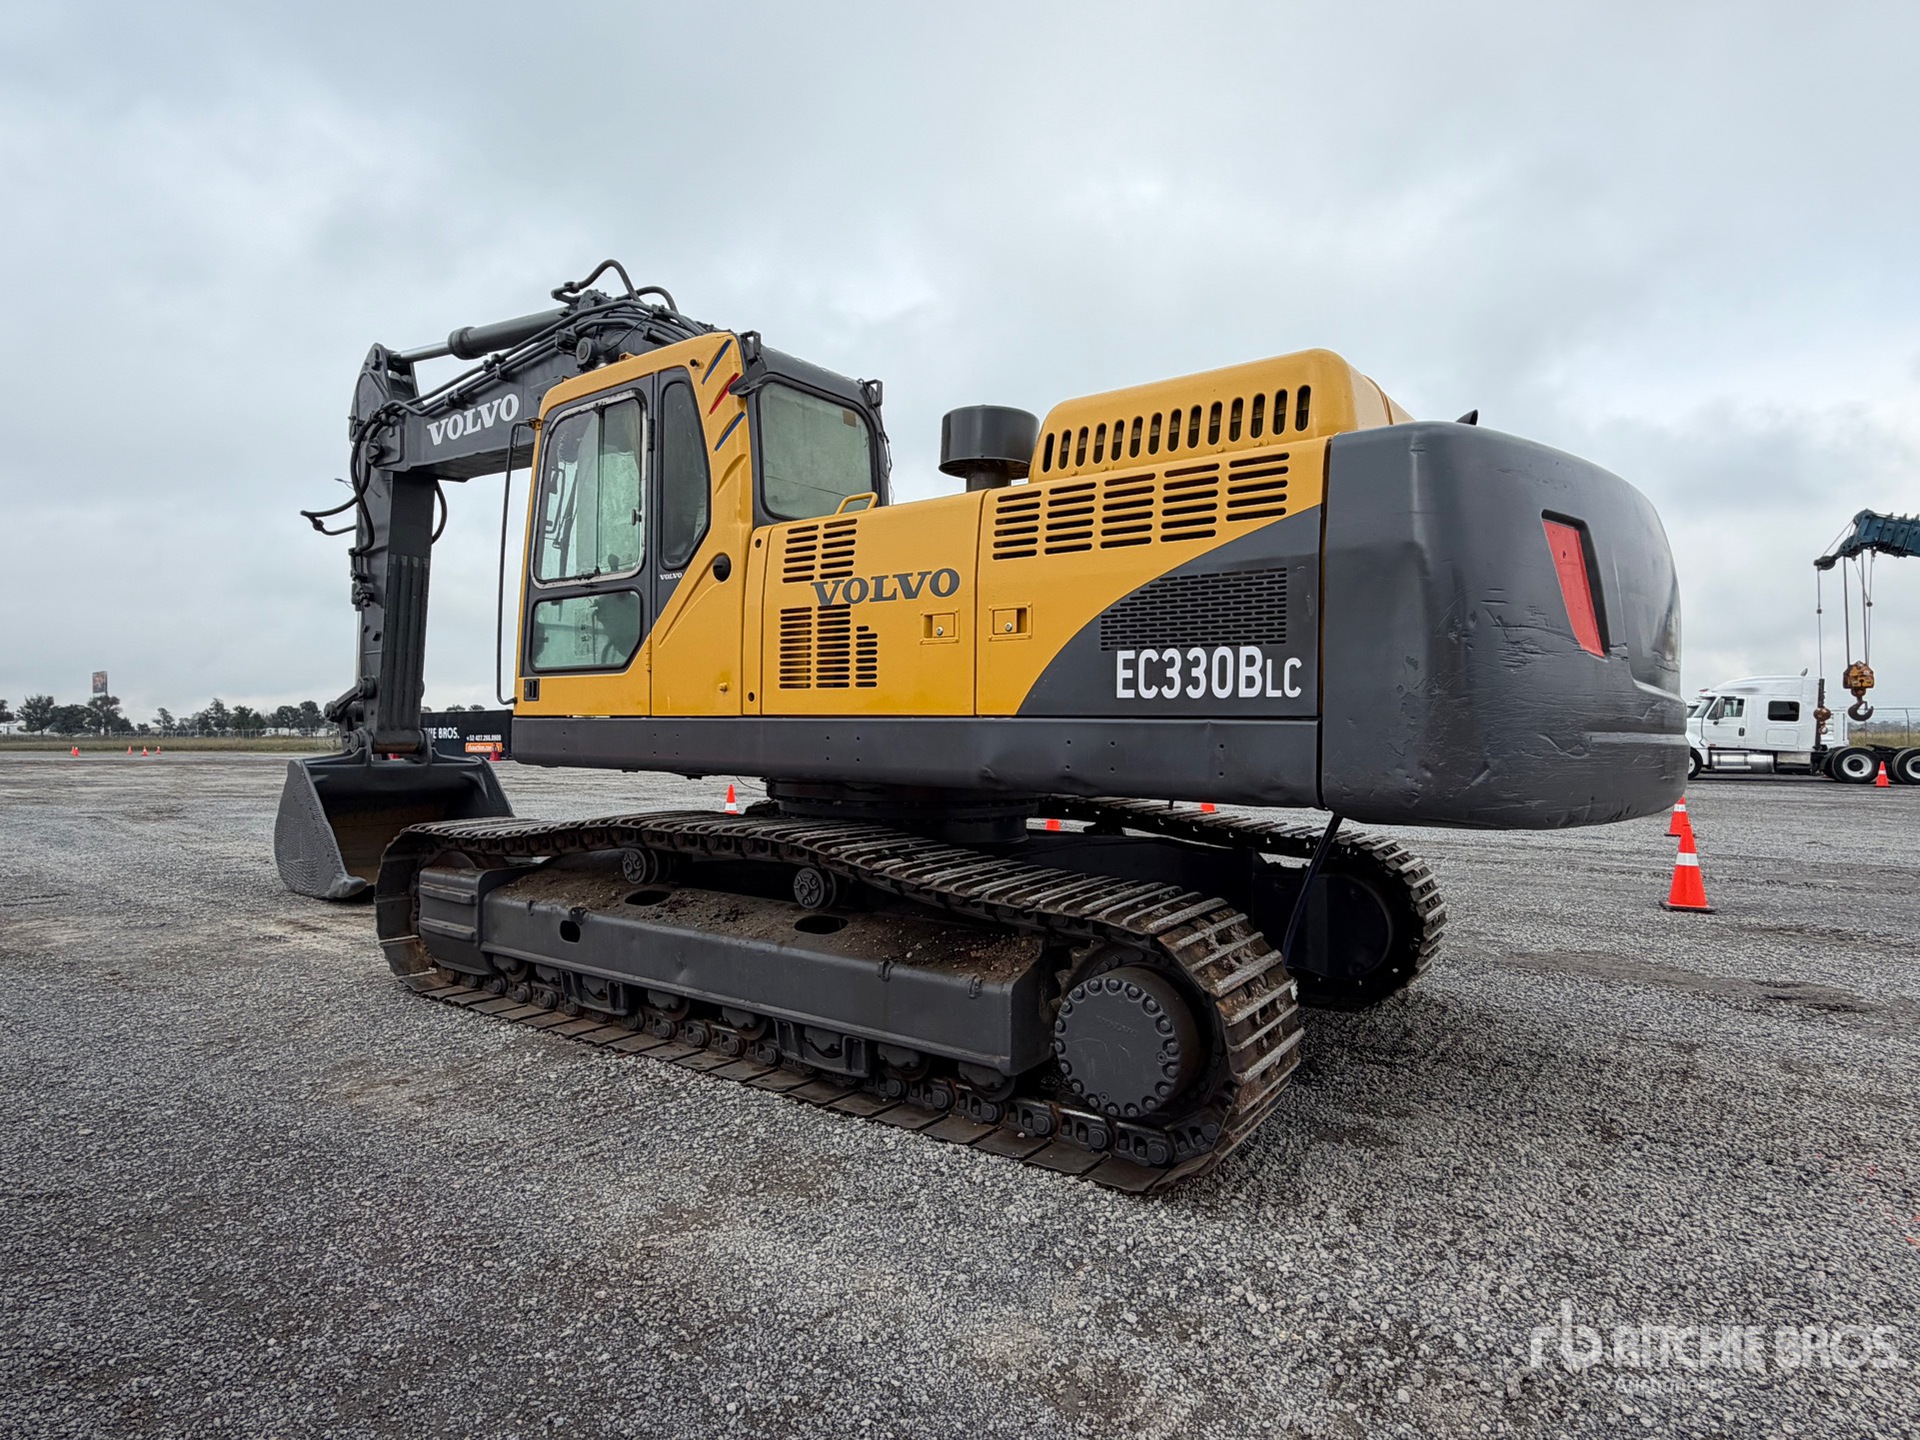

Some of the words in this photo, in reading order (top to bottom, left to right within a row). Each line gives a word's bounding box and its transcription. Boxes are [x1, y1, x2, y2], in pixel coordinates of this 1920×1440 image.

[426, 393, 520, 446] VOLVO
[659, 572, 683, 581] VOLVO
[810, 567, 961, 607] VOLVO
[1116, 645, 1302, 699] EC330BLC
[438, 727, 460, 740] BROS.
